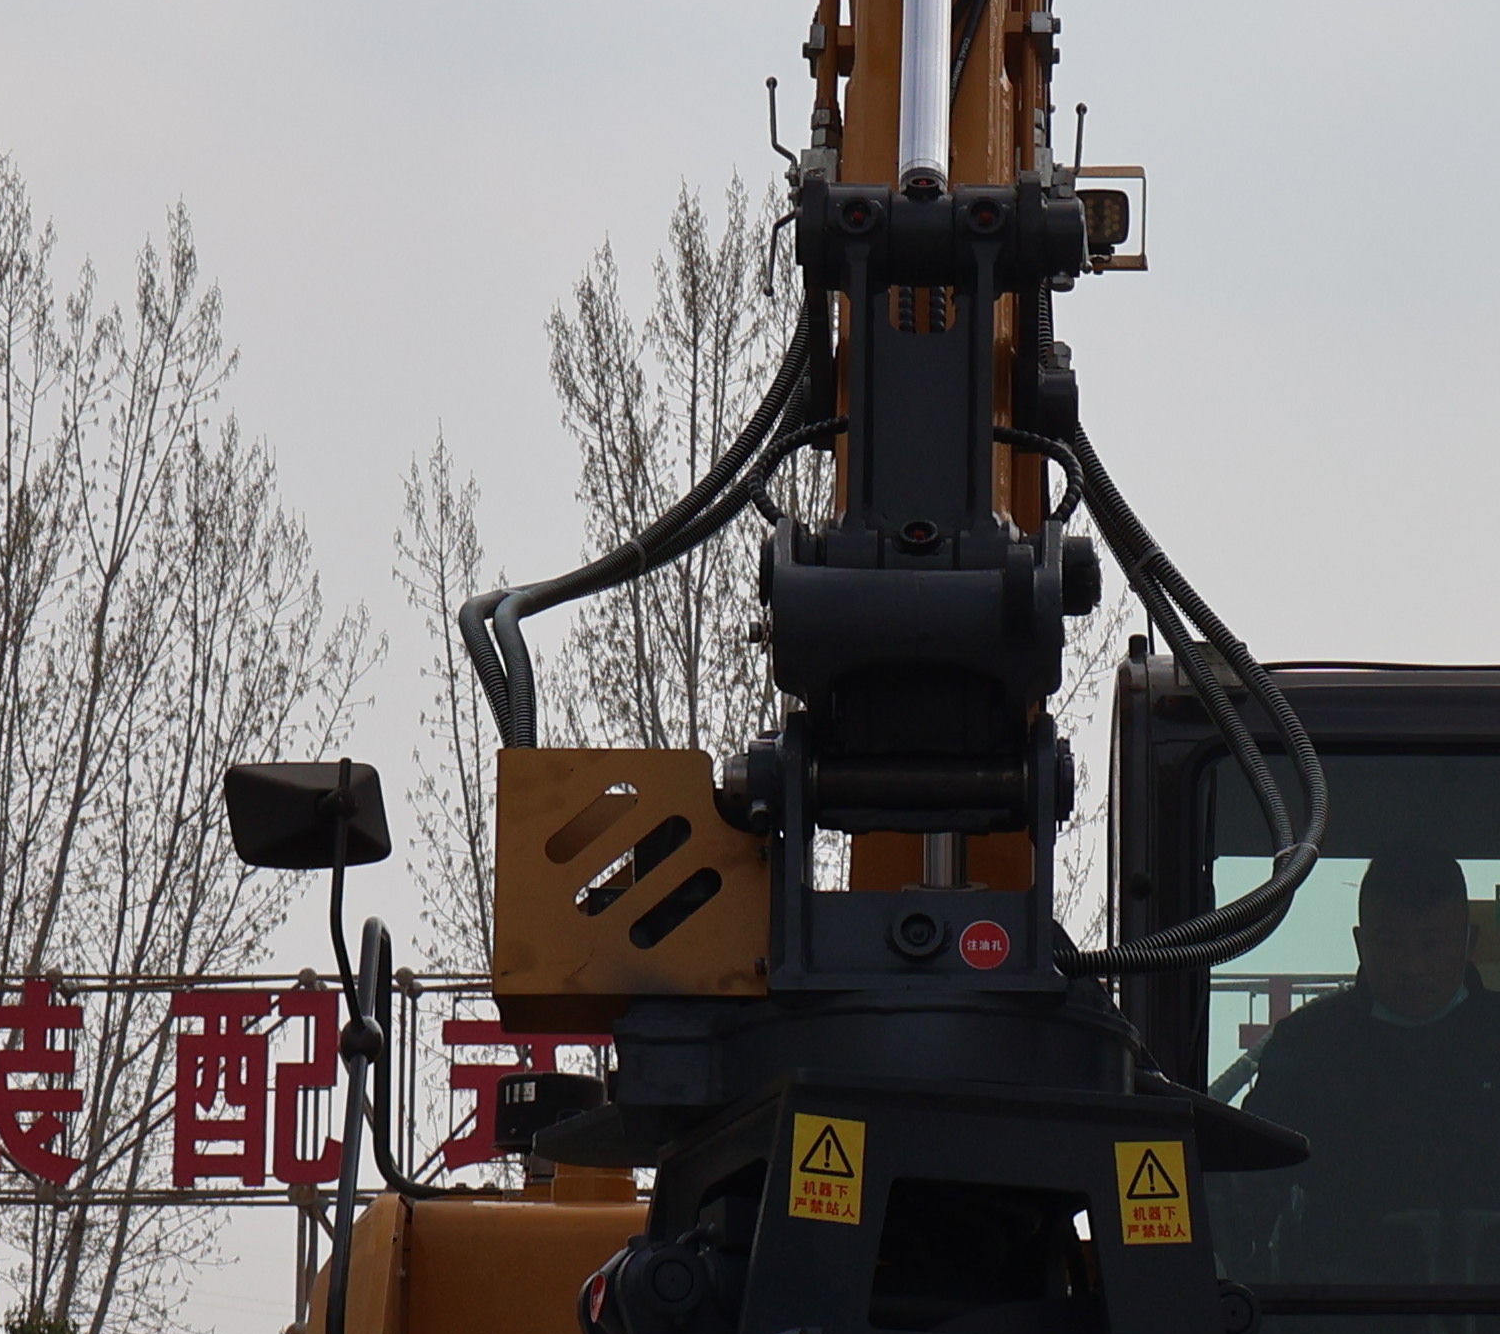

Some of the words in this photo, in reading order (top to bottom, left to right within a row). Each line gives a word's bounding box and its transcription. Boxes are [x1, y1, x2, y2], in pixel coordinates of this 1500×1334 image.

[966, 938, 1003, 952] 注油孔
[802, 1180, 849, 1200] 机器下
[793, 1196, 856, 1218] 严禁站人
[1132, 1205, 1177, 1222] 机器下
[1126, 1223, 1187, 1239] 严禁站人
